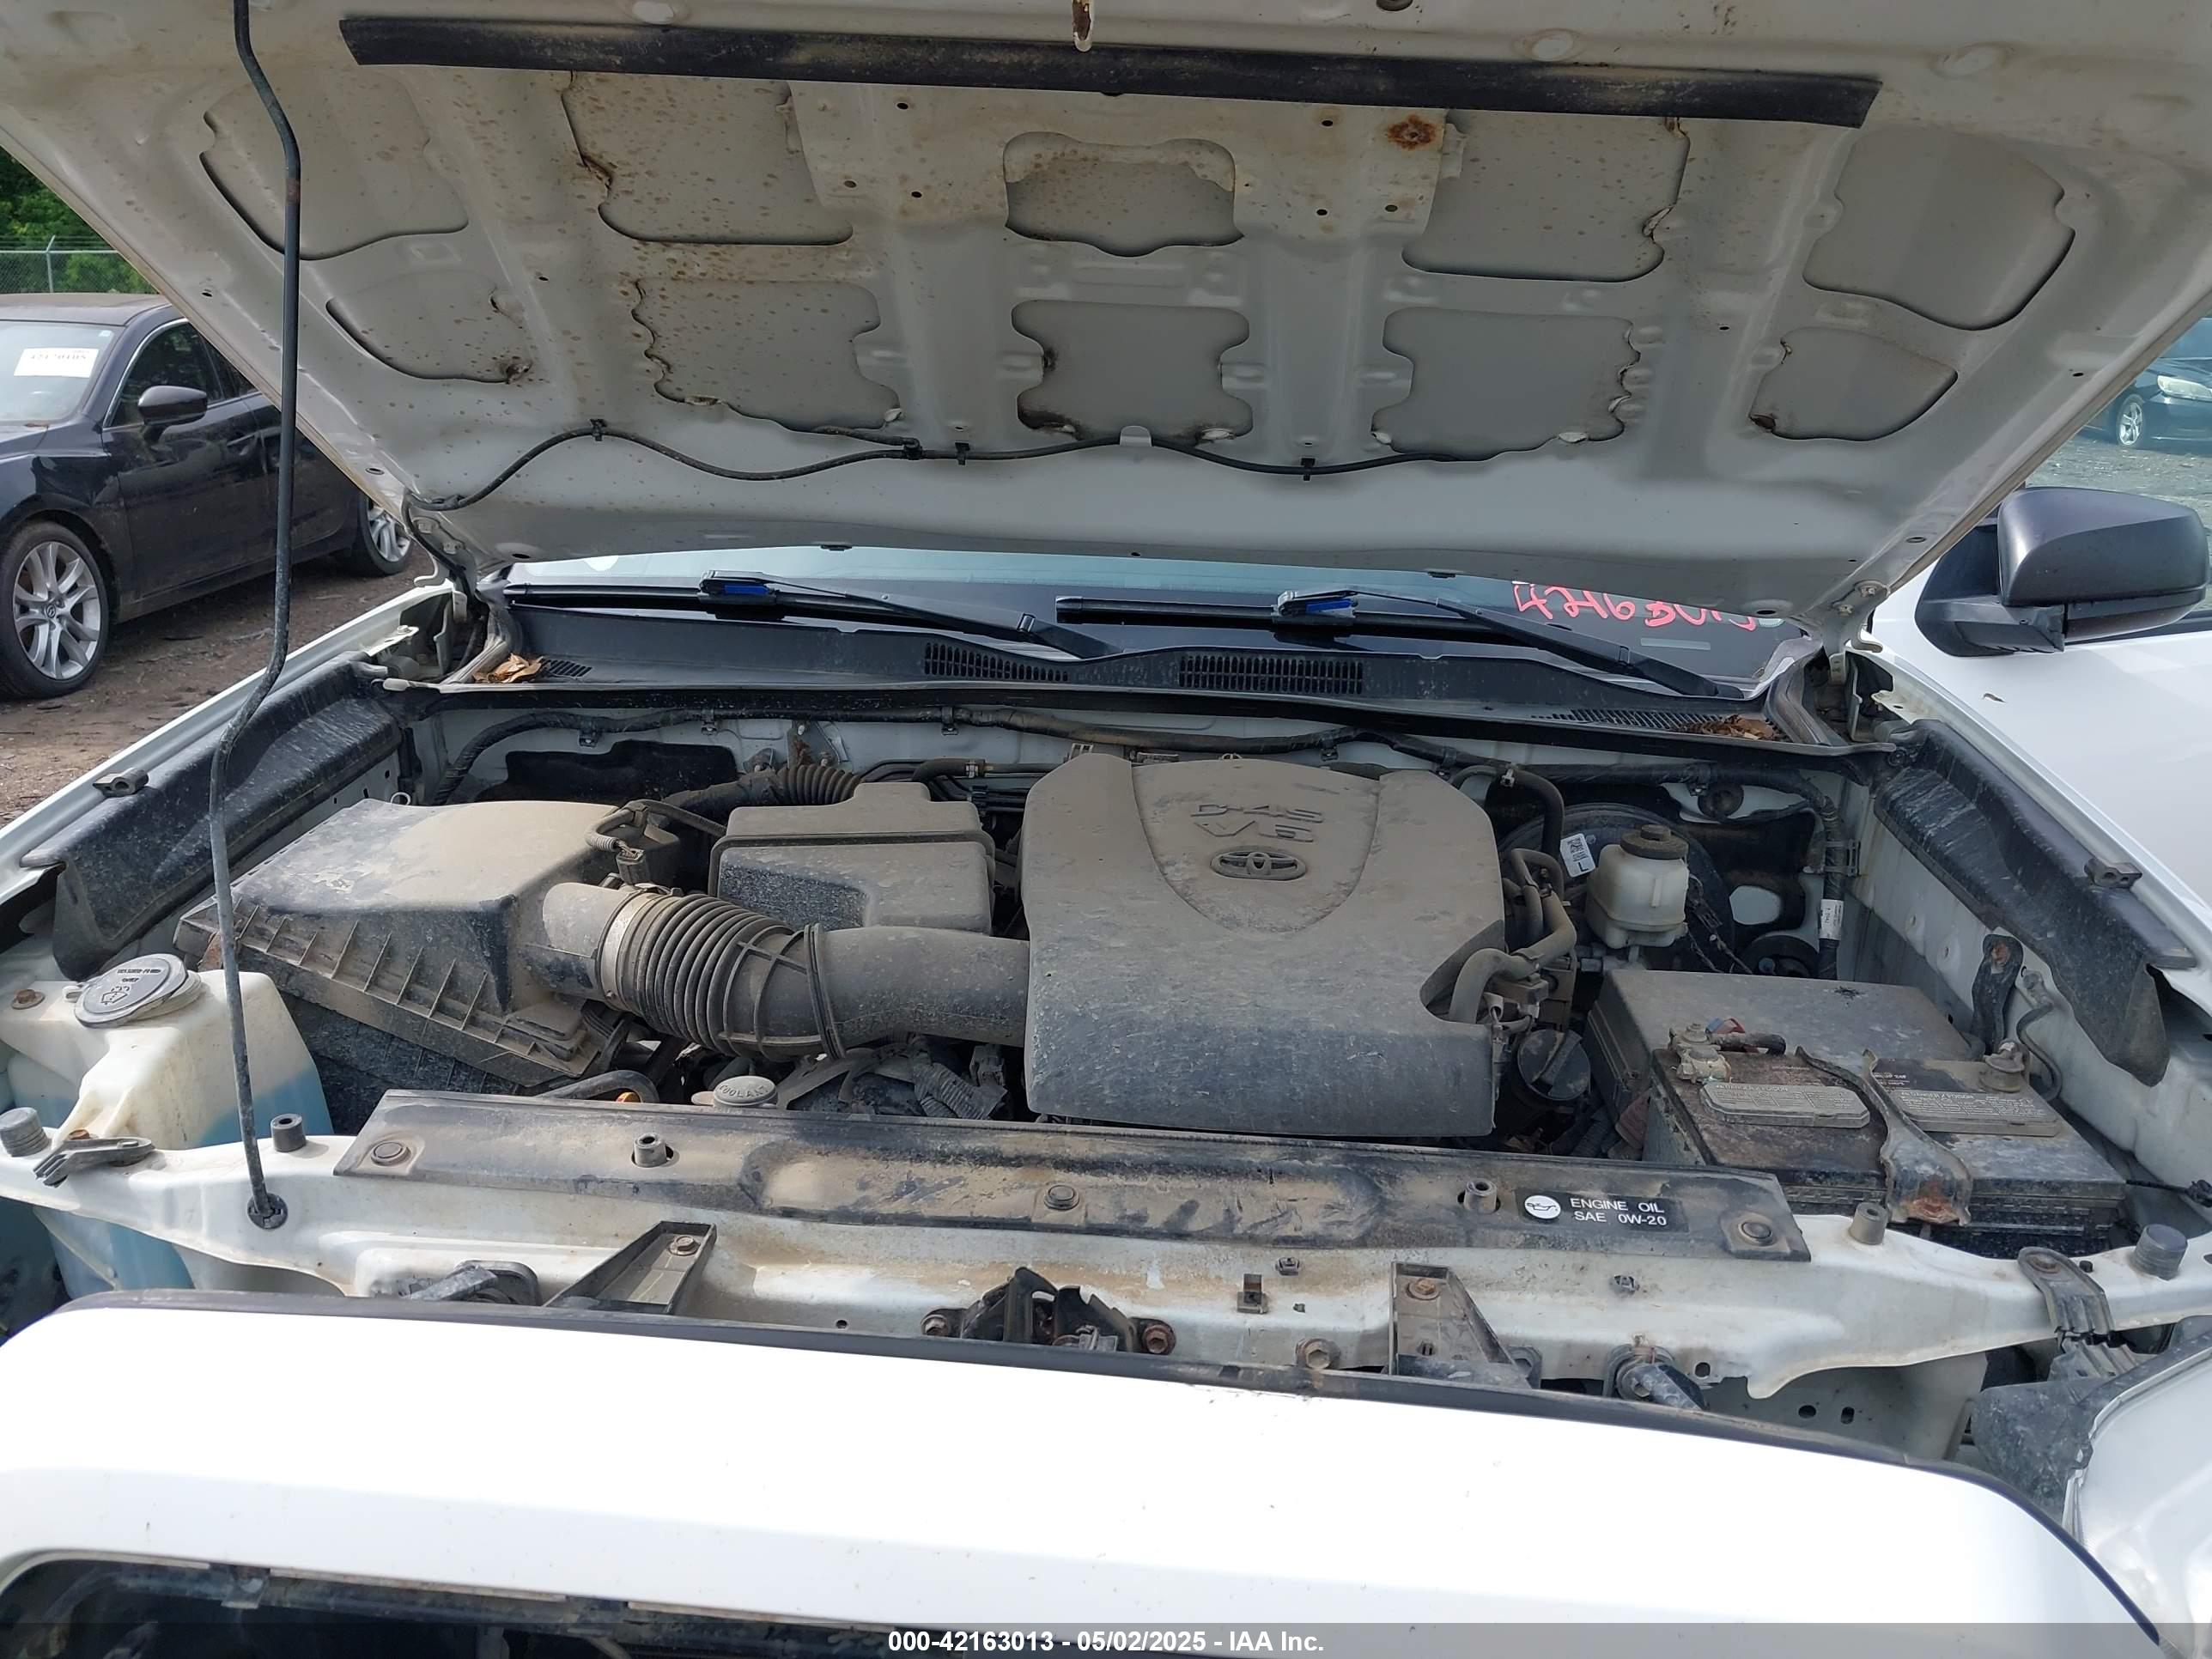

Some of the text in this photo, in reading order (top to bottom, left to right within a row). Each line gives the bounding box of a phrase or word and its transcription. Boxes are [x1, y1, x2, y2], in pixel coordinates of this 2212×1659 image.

[718, 1084, 769, 1099] COOLANT
[1571, 1198, 1665, 1213] ENGINE OIL
[1573, 1210, 1668, 1226] SAE 0W-20
